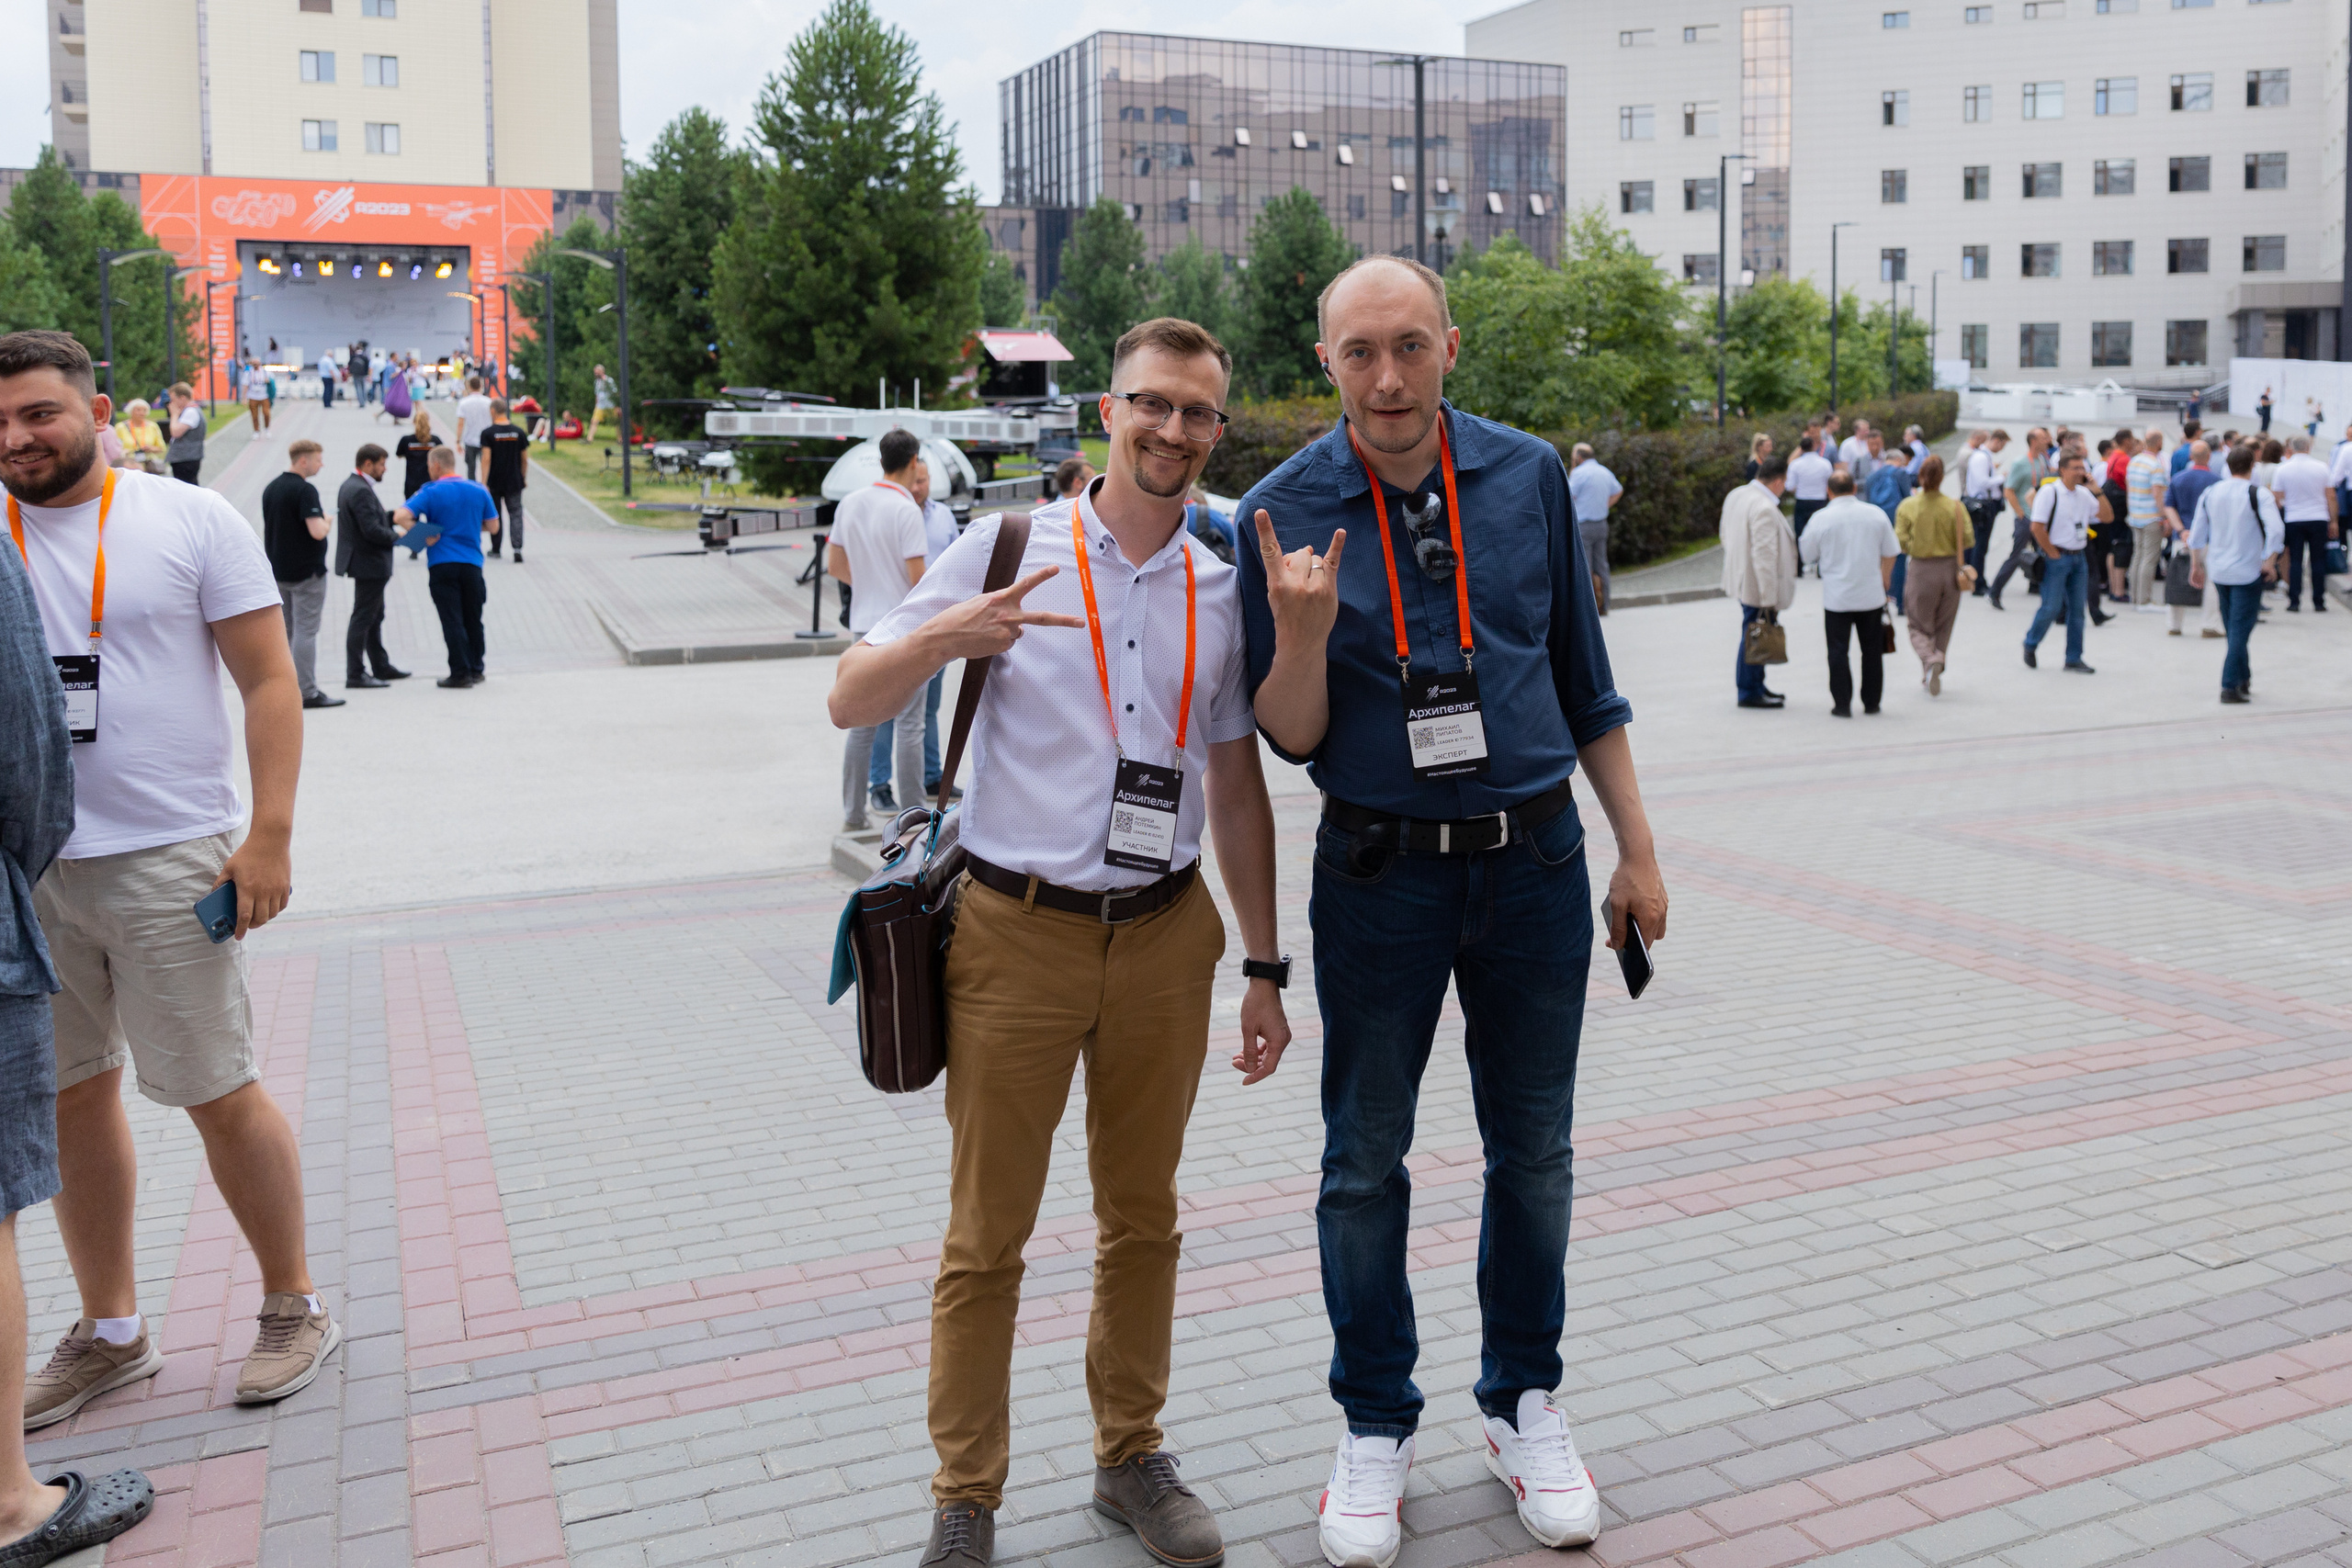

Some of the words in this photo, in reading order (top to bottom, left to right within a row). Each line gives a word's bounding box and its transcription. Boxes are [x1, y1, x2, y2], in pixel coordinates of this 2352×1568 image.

[1408, 702, 1476, 719] Архипелаг
[1435, 724, 1460, 732] МИХАИЛ
[1432, 750, 1468, 761] ЭКСПЕРТ
[1116, 789, 1175, 808] Архипелаг
[1135, 816, 1155, 824] АНДРЕЙ
[1122, 840, 1159, 853] УЧАСТНИК
